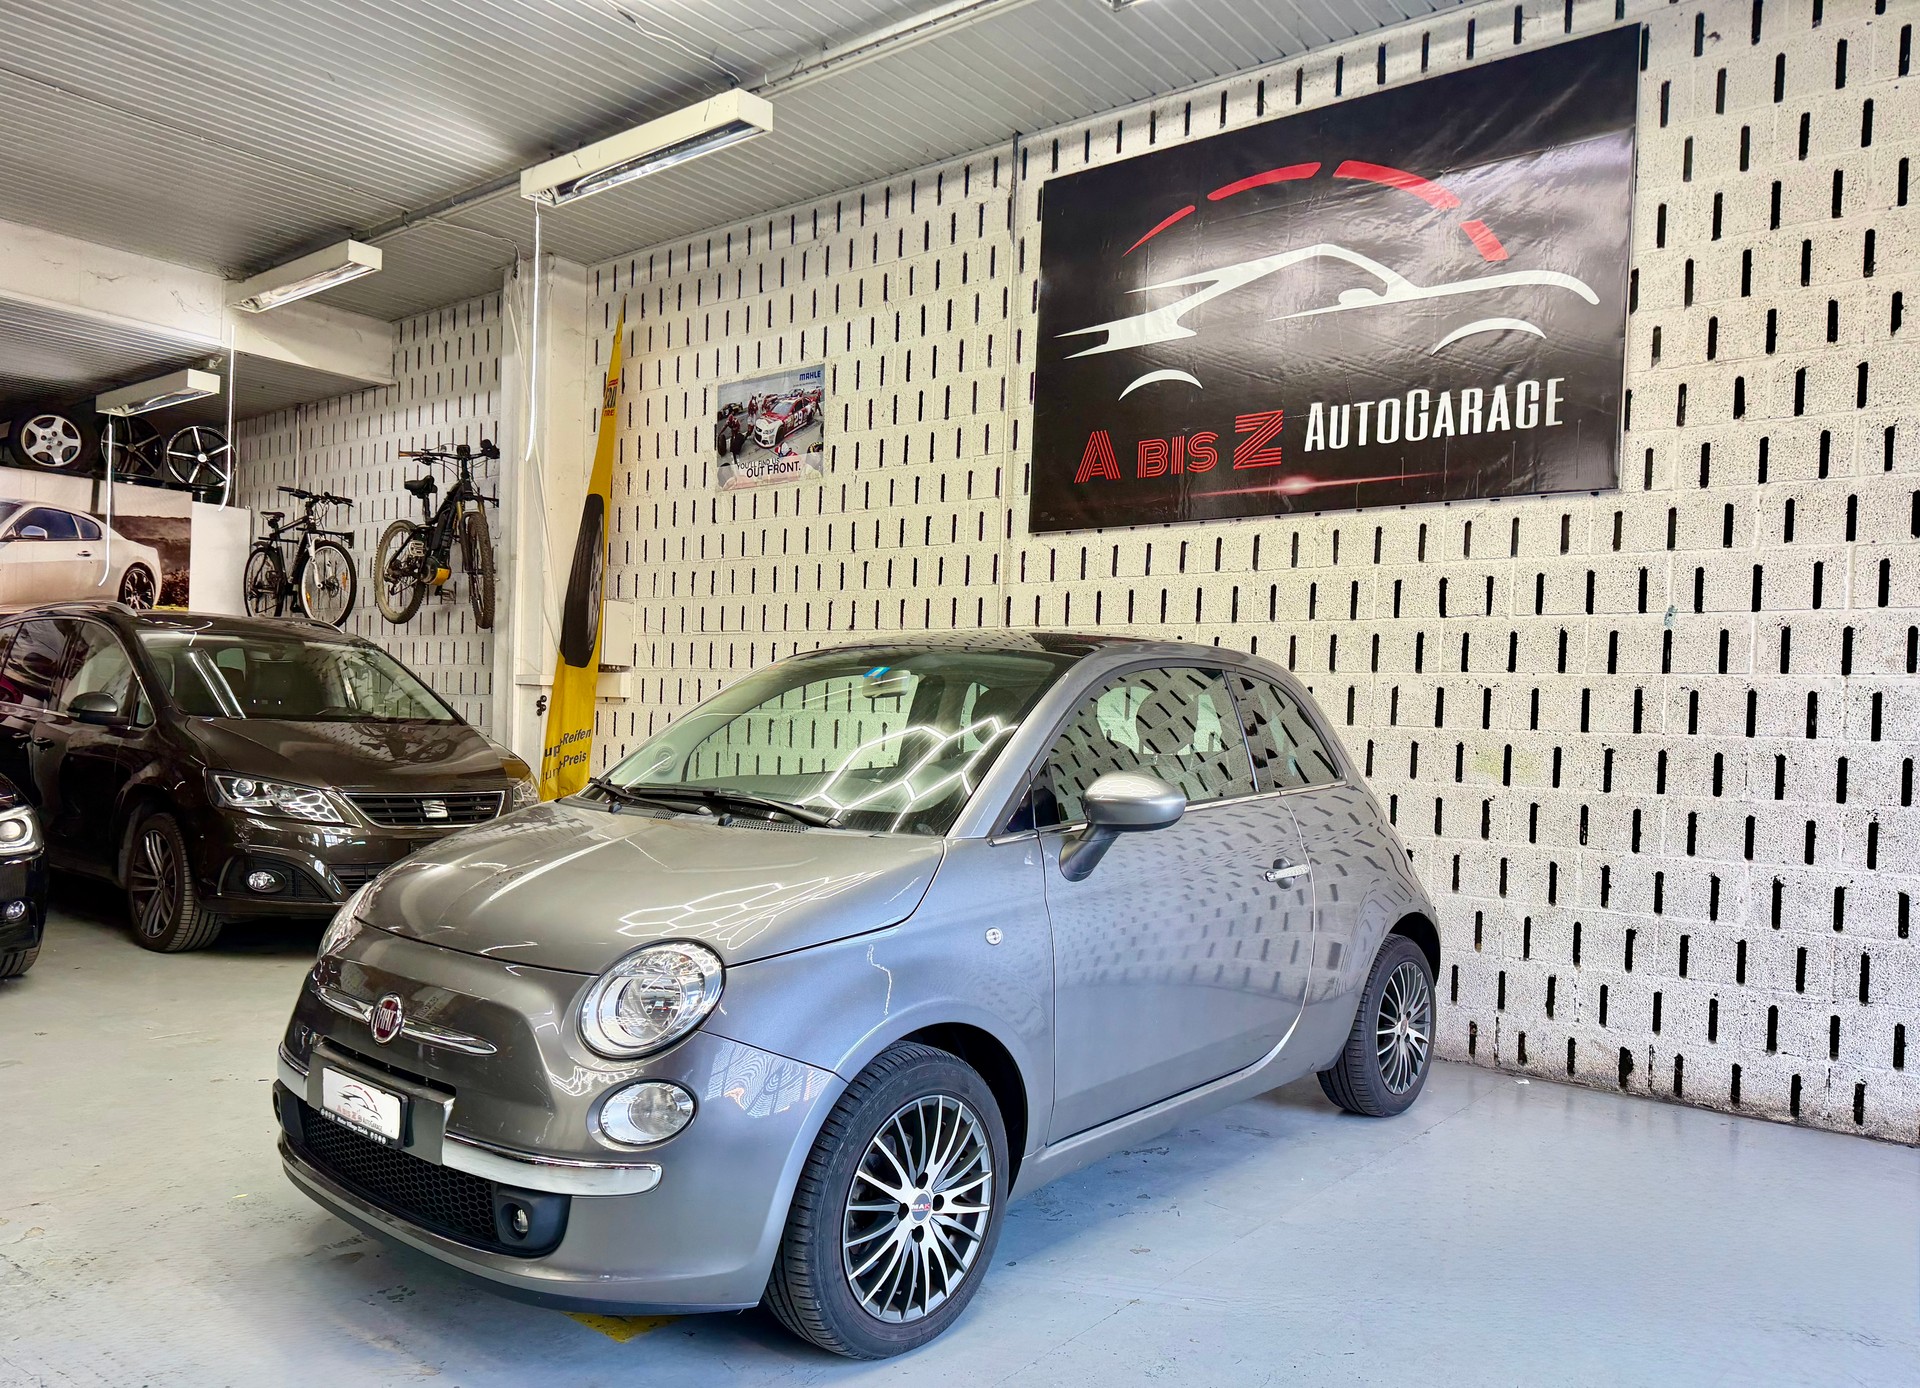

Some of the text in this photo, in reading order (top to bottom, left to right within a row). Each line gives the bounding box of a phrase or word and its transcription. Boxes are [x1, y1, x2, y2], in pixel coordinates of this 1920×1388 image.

[799, 370, 821, 381] MAHLE
[1074, 377, 1567, 484] A BIS Z AUTOGARAGE
[746, 460, 801, 479] OUT FRONT.
[375, 1004, 397, 1032] FIAT
[910, 1201, 931, 1211] MAK
